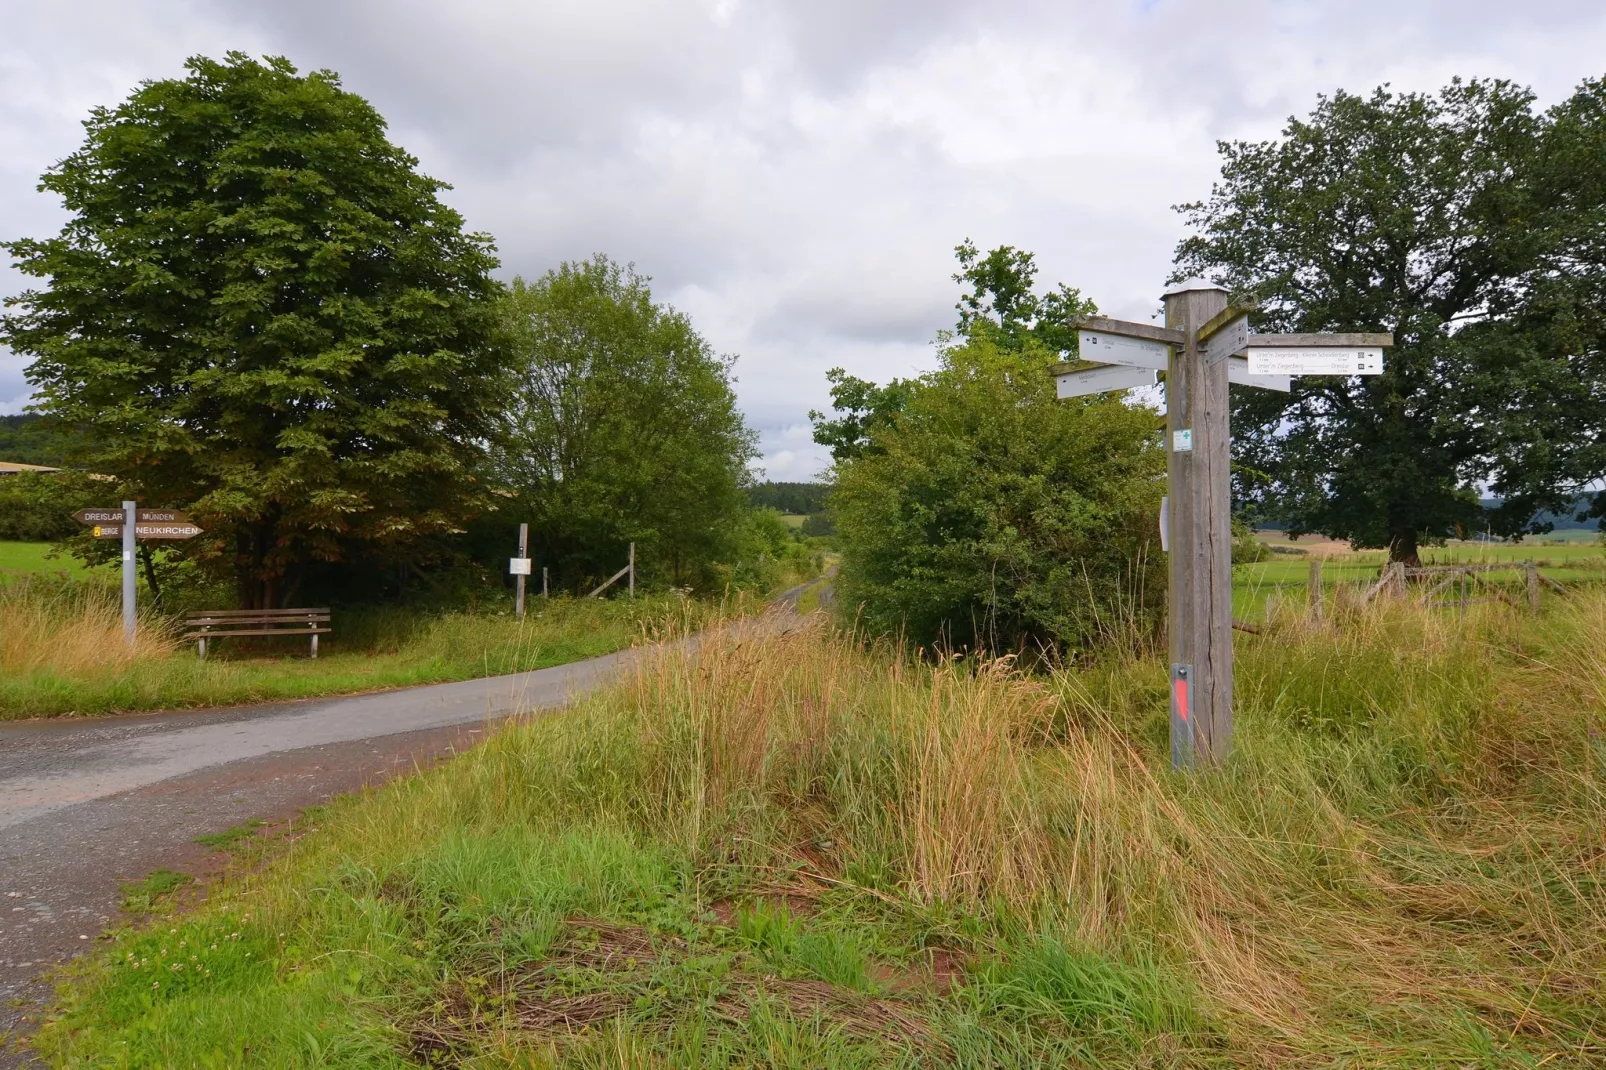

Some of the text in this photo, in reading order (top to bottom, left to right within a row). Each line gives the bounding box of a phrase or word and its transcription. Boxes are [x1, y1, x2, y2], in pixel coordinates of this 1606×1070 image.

[84, 513, 123, 521] DREISLAR
[142, 511, 175, 521] MÜNDEN
[101, 527, 119, 536] BERGE
[136, 526, 198, 535] NEUKIRCHEN
